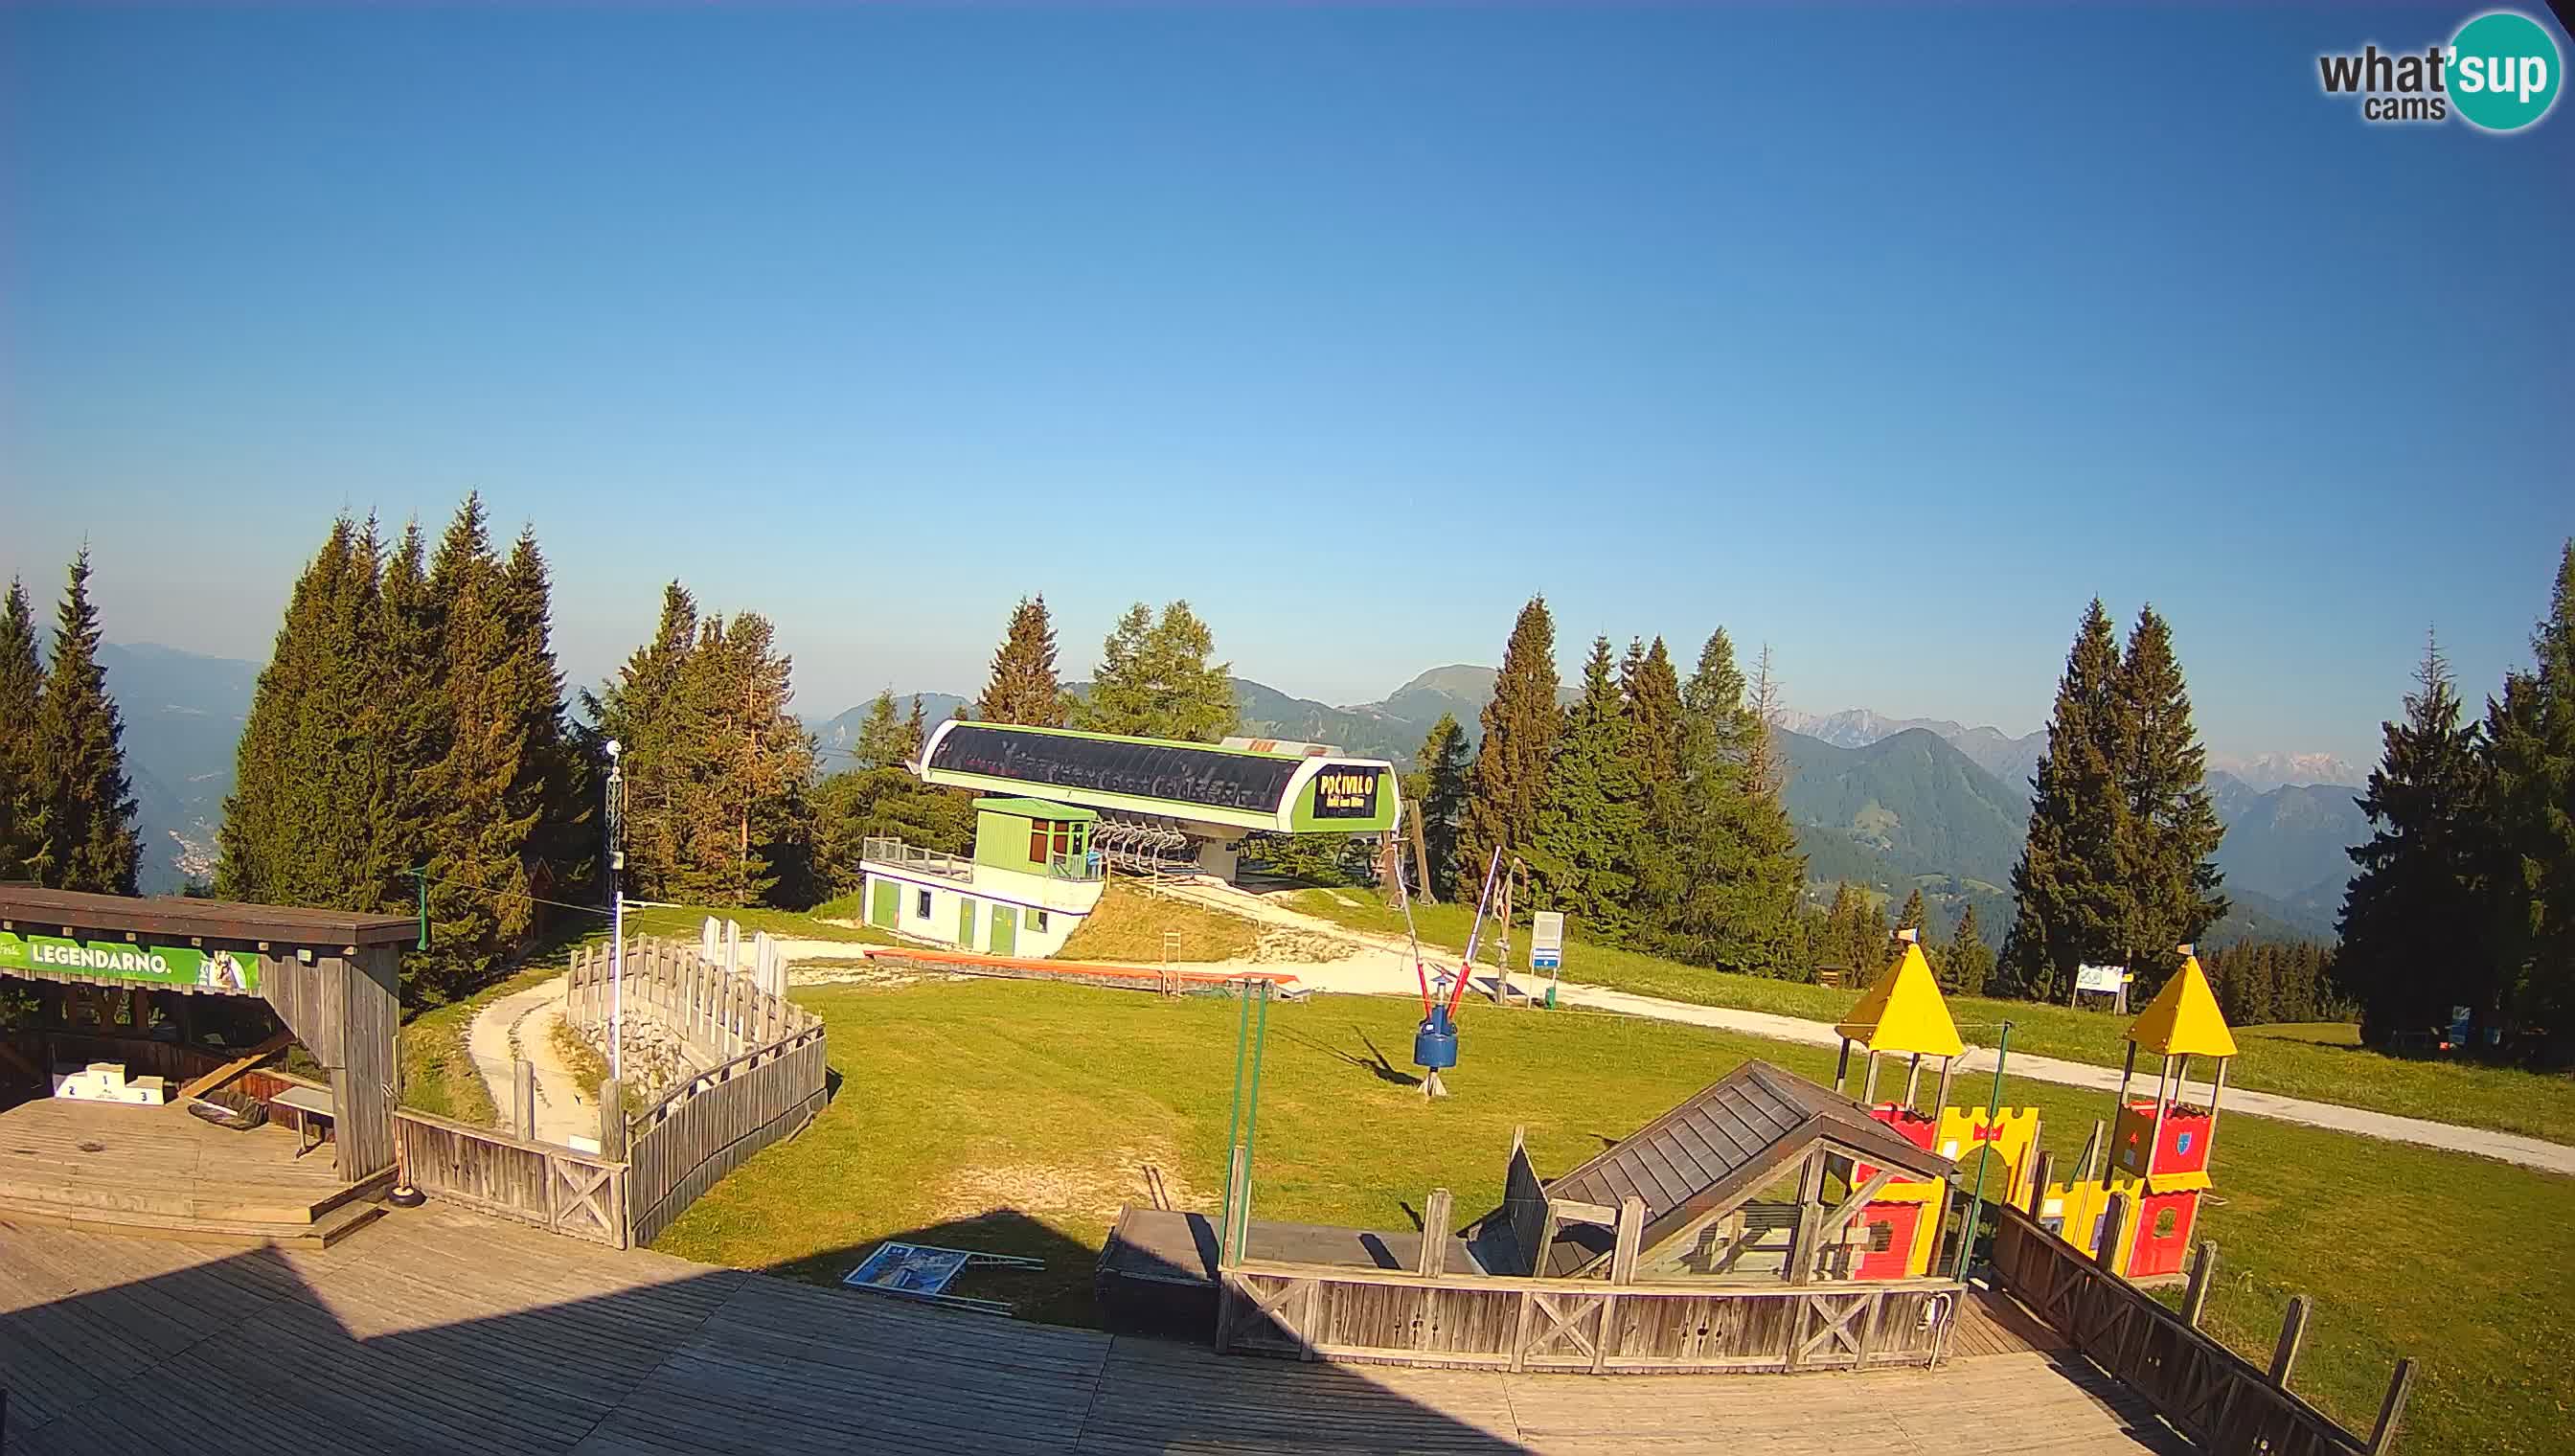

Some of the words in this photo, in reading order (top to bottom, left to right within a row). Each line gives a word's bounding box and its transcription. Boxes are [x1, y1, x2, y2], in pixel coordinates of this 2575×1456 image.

[32, 944, 172, 974] LEGENDARNO.
[68, 1085, 76, 1096] 2
[140, 1091, 148, 1102] 3
